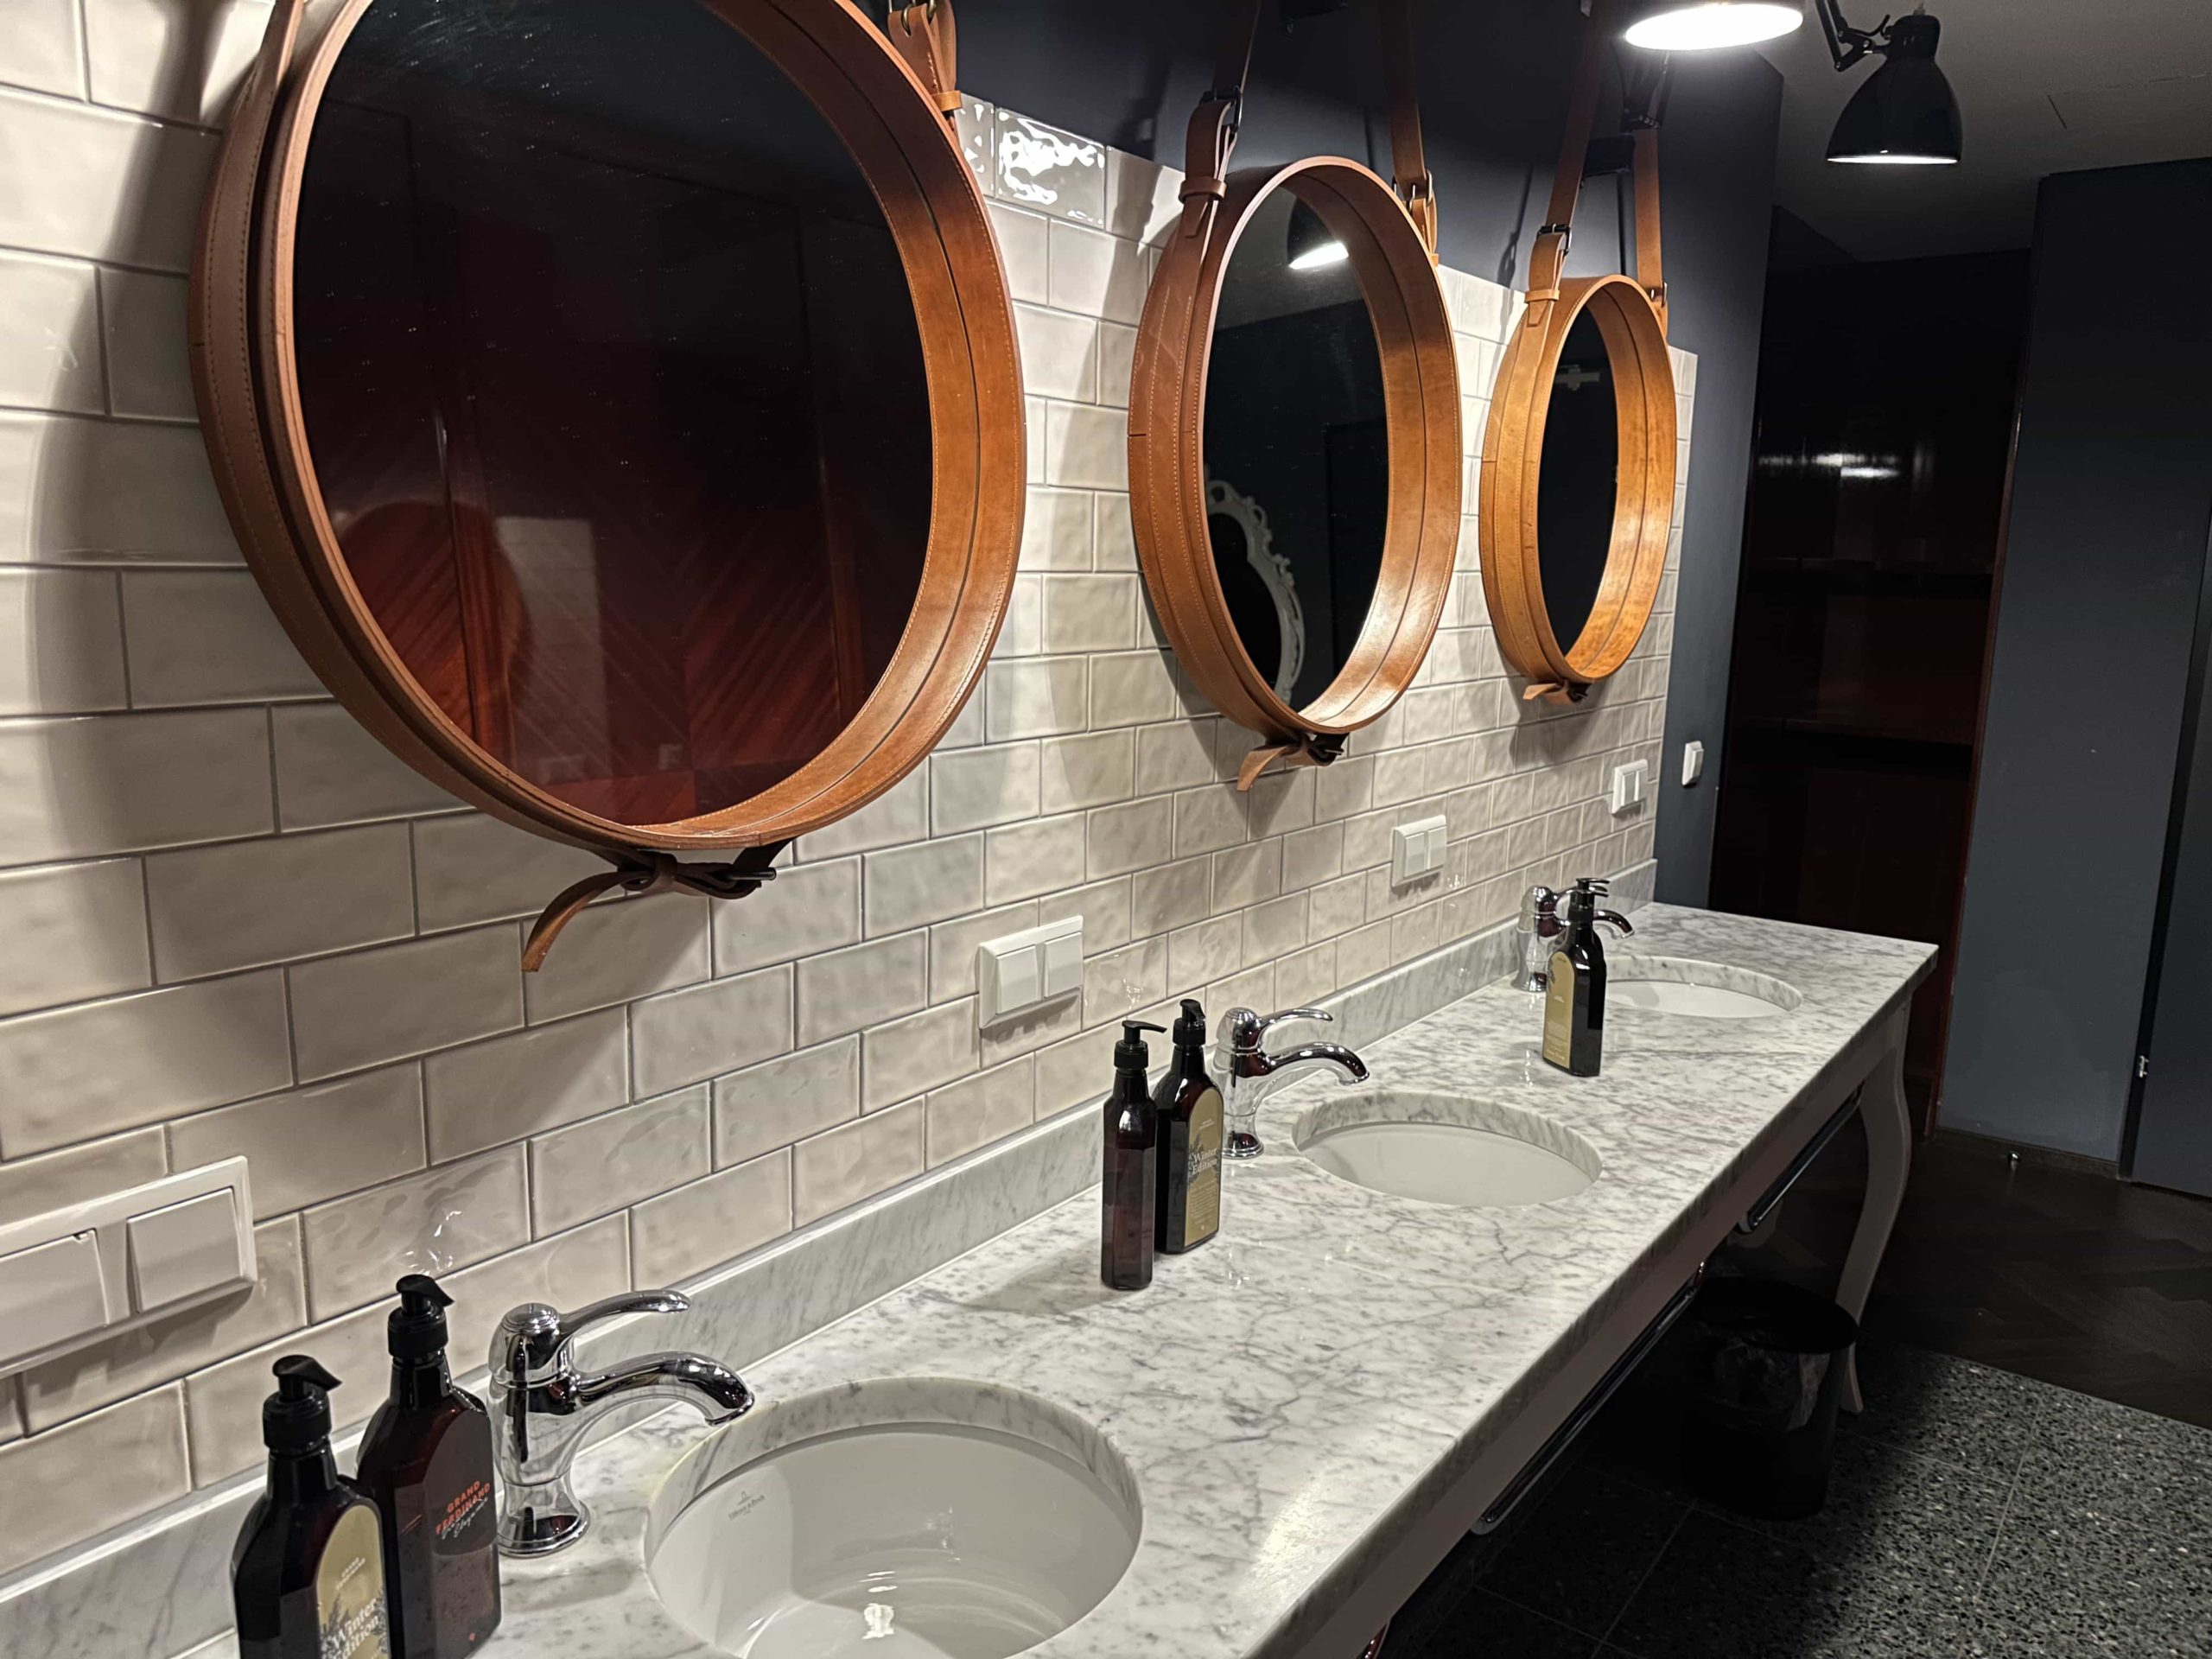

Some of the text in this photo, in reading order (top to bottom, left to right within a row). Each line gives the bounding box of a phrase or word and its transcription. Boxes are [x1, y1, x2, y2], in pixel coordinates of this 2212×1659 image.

[1192, 1147, 1217, 1163] Winter
[1192, 1159, 1217, 1175] Edition
[435, 1482, 490, 1535] FERDINAND
[446, 1480, 481, 1513] GRAND
[332, 1598, 377, 1649] Winter
